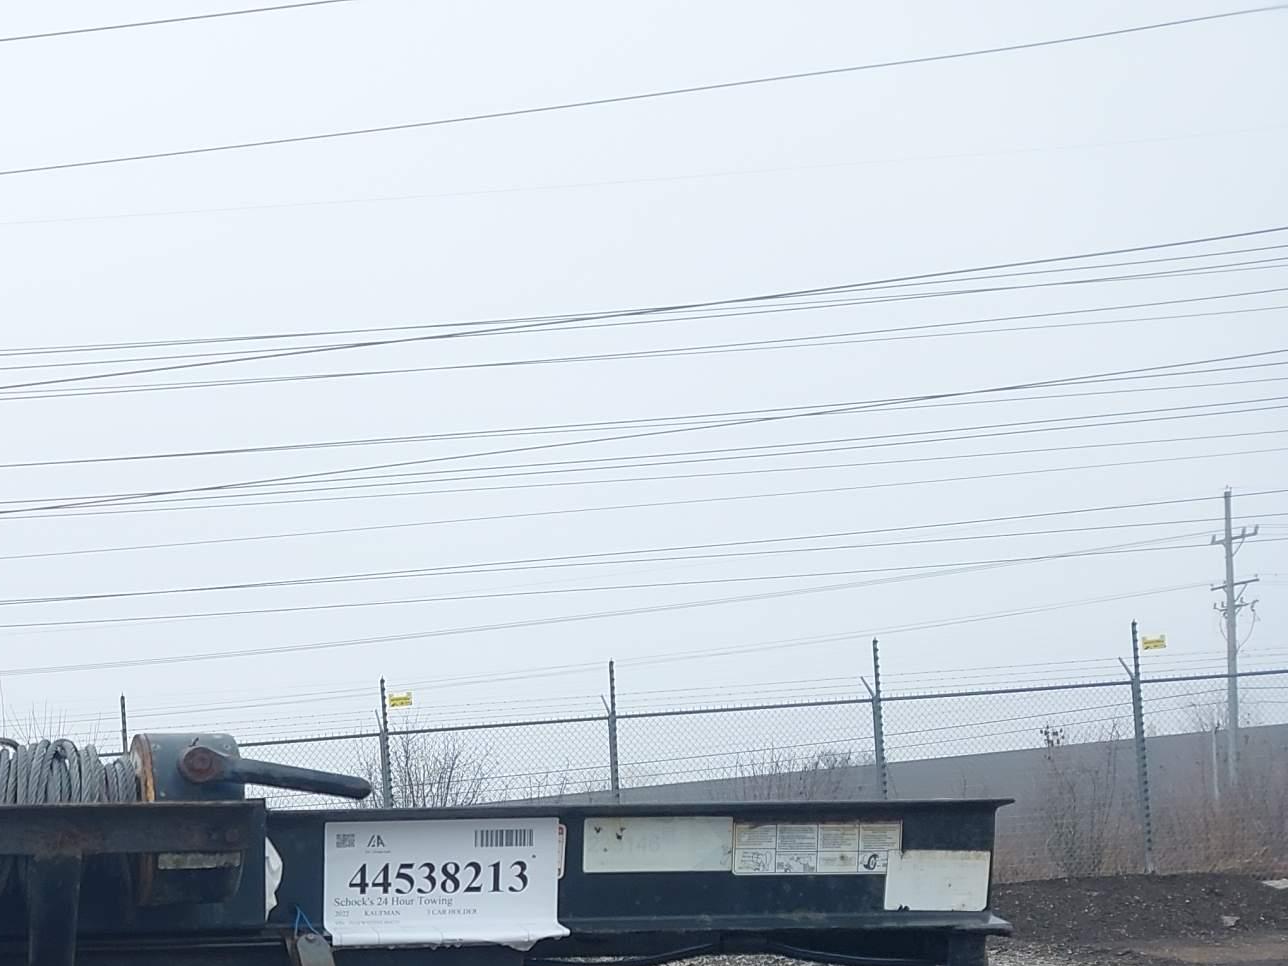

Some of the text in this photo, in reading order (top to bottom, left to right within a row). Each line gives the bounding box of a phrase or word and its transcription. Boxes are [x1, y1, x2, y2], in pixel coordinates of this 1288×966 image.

[348, 860, 529, 895] 44538213
[334, 896, 453, 907] Schock's 24 Hour Towing
